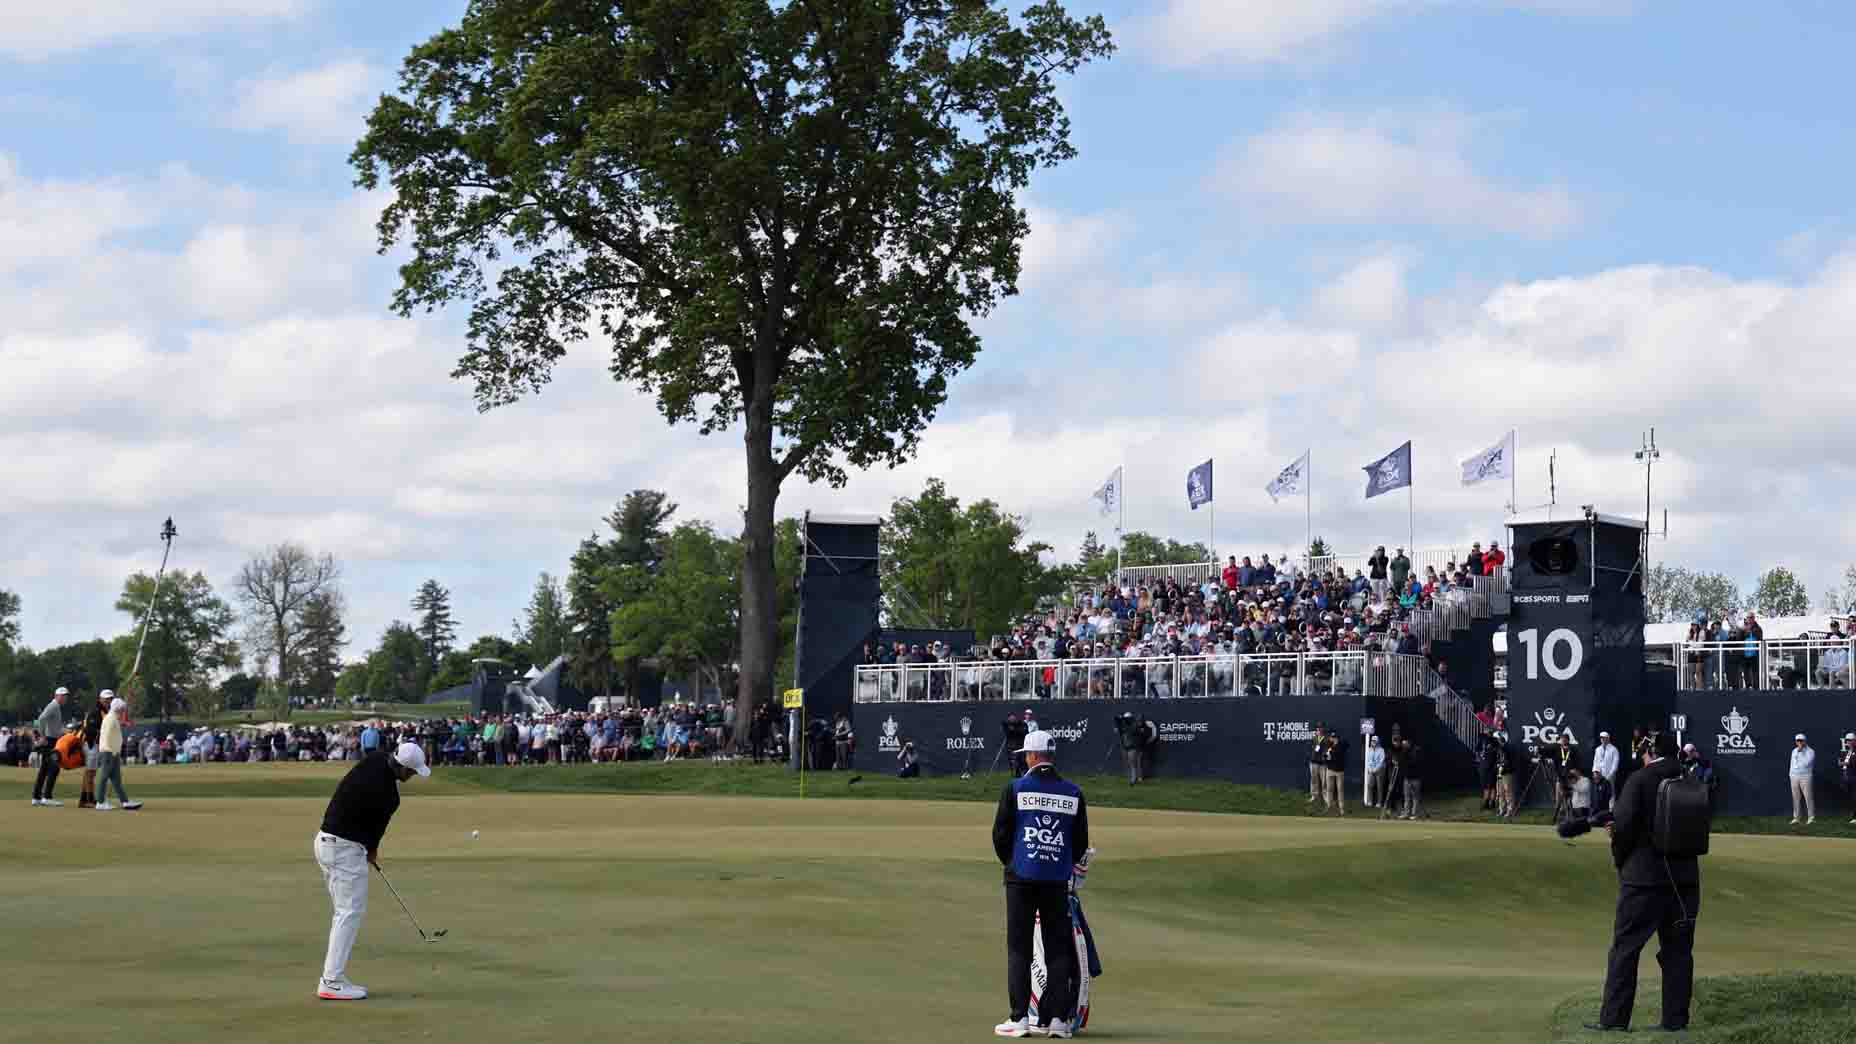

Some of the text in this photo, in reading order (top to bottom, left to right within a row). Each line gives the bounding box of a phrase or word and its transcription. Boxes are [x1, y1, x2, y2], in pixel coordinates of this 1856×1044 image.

[1518, 628, 1583, 681] 10
[1160, 722, 1208, 731] SAPPHIRE
[1277, 722, 1309, 731] T-MOBILE
[1671, 715, 1685, 729] 10
[1046, 726, 1082, 741] ebridge
[1277, 731, 1290, 740] FOR
[1521, 725, 1578, 744] PGA
[879, 736, 900, 746] PGA
[946, 737, 984, 749] ROLEX
[1716, 734, 1756, 747] PGA
[1022, 796, 1074, 810] SCHEFFLER
[1023, 826, 1065, 846] PGA
[1036, 844, 1061, 853] AMERICA
